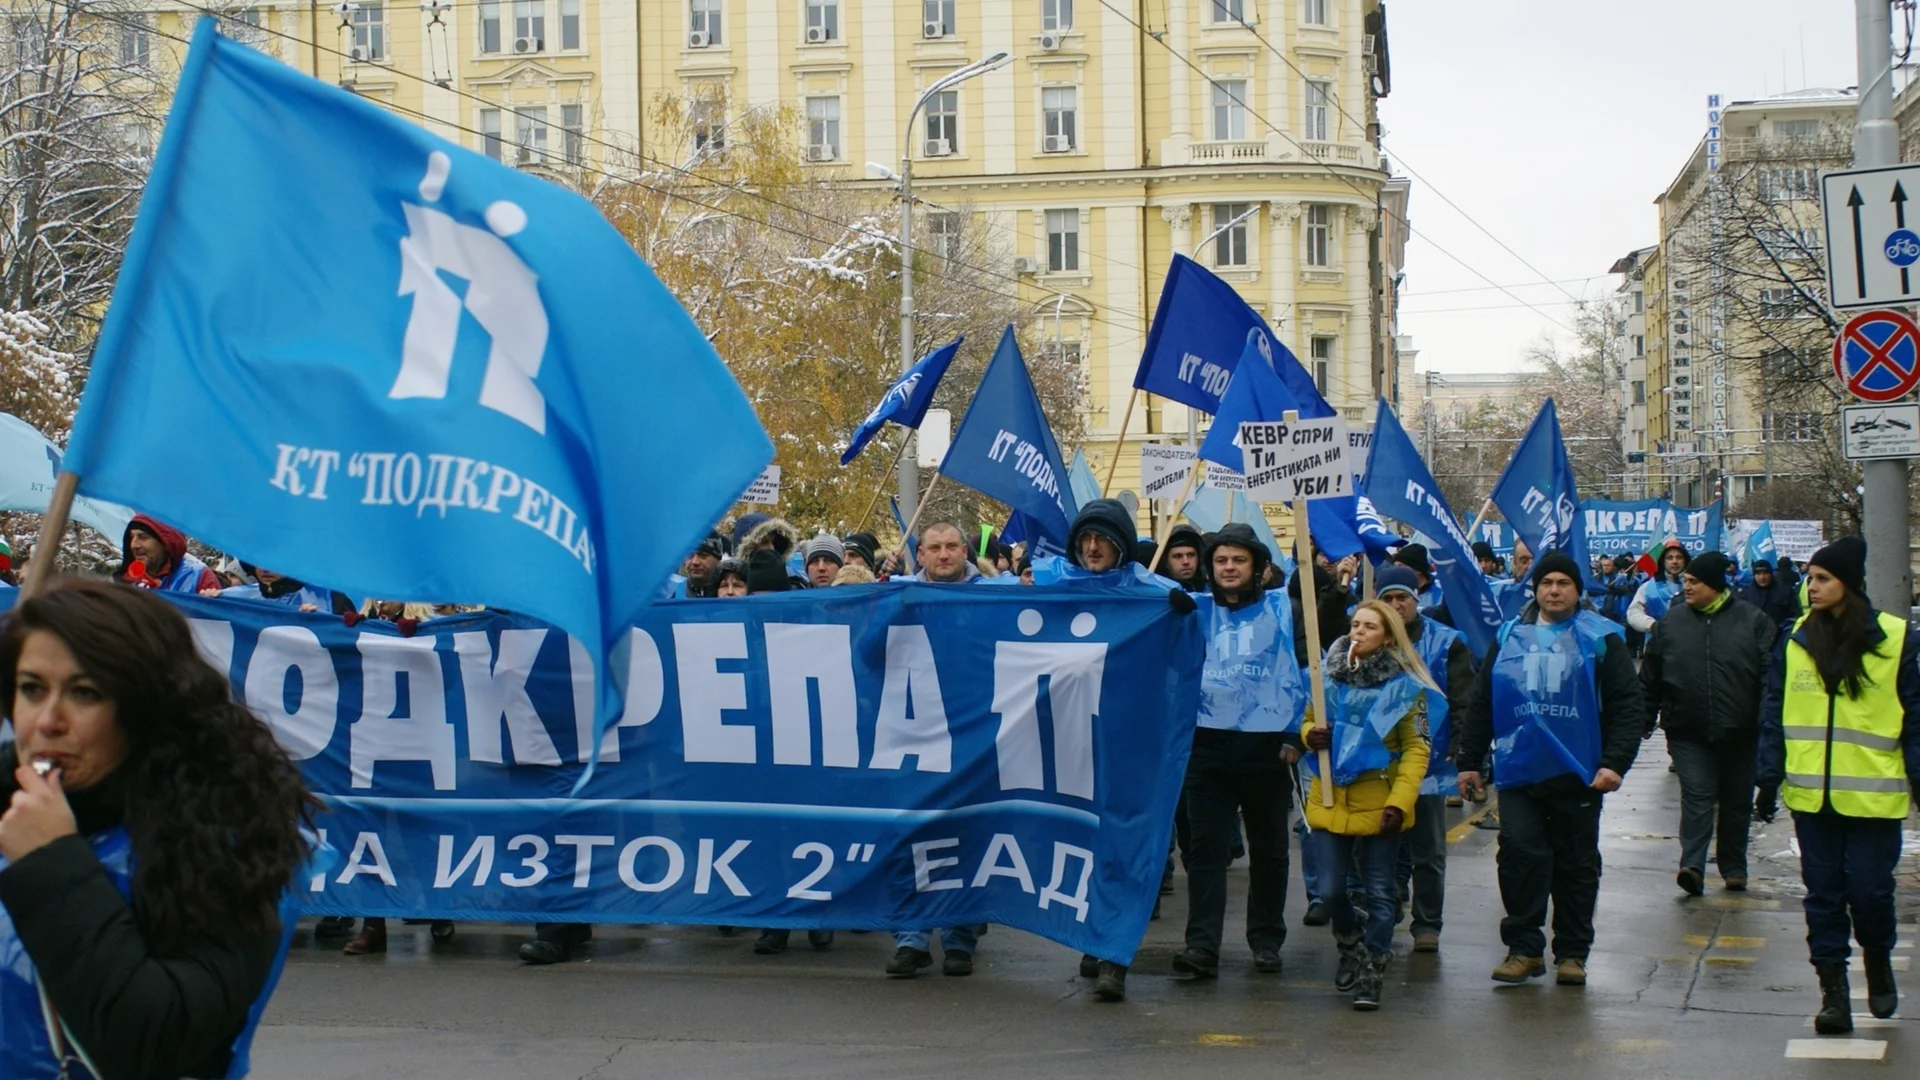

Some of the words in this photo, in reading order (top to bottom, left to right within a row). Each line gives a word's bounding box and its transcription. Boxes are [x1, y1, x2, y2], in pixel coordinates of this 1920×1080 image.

[1709, 95, 1719, 170] HOTEL
[1178, 352, 1202, 384] КТ
[988, 429, 1018, 462] КТ
[1241, 425, 1289, 445] КЕВР
[1292, 427, 1333, 445] СПРИ
[269, 444, 340, 500] КТ
[1146, 469, 1184, 495] ПРЕДАТЕЛИ
[1247, 454, 1322, 489] ЕНЕРГЕТИКАТА
[1324, 446, 1341, 463] НИ
[1293, 475, 1329, 496] УБИ
[1405, 479, 1426, 506] КТ
[1520, 486, 1546, 515] КТ
[1514, 701, 1579, 718] ПОДКРЕПА
[433, 833, 753, 897] ИЗТОК
[911, 833, 1095, 923] ЕАД
